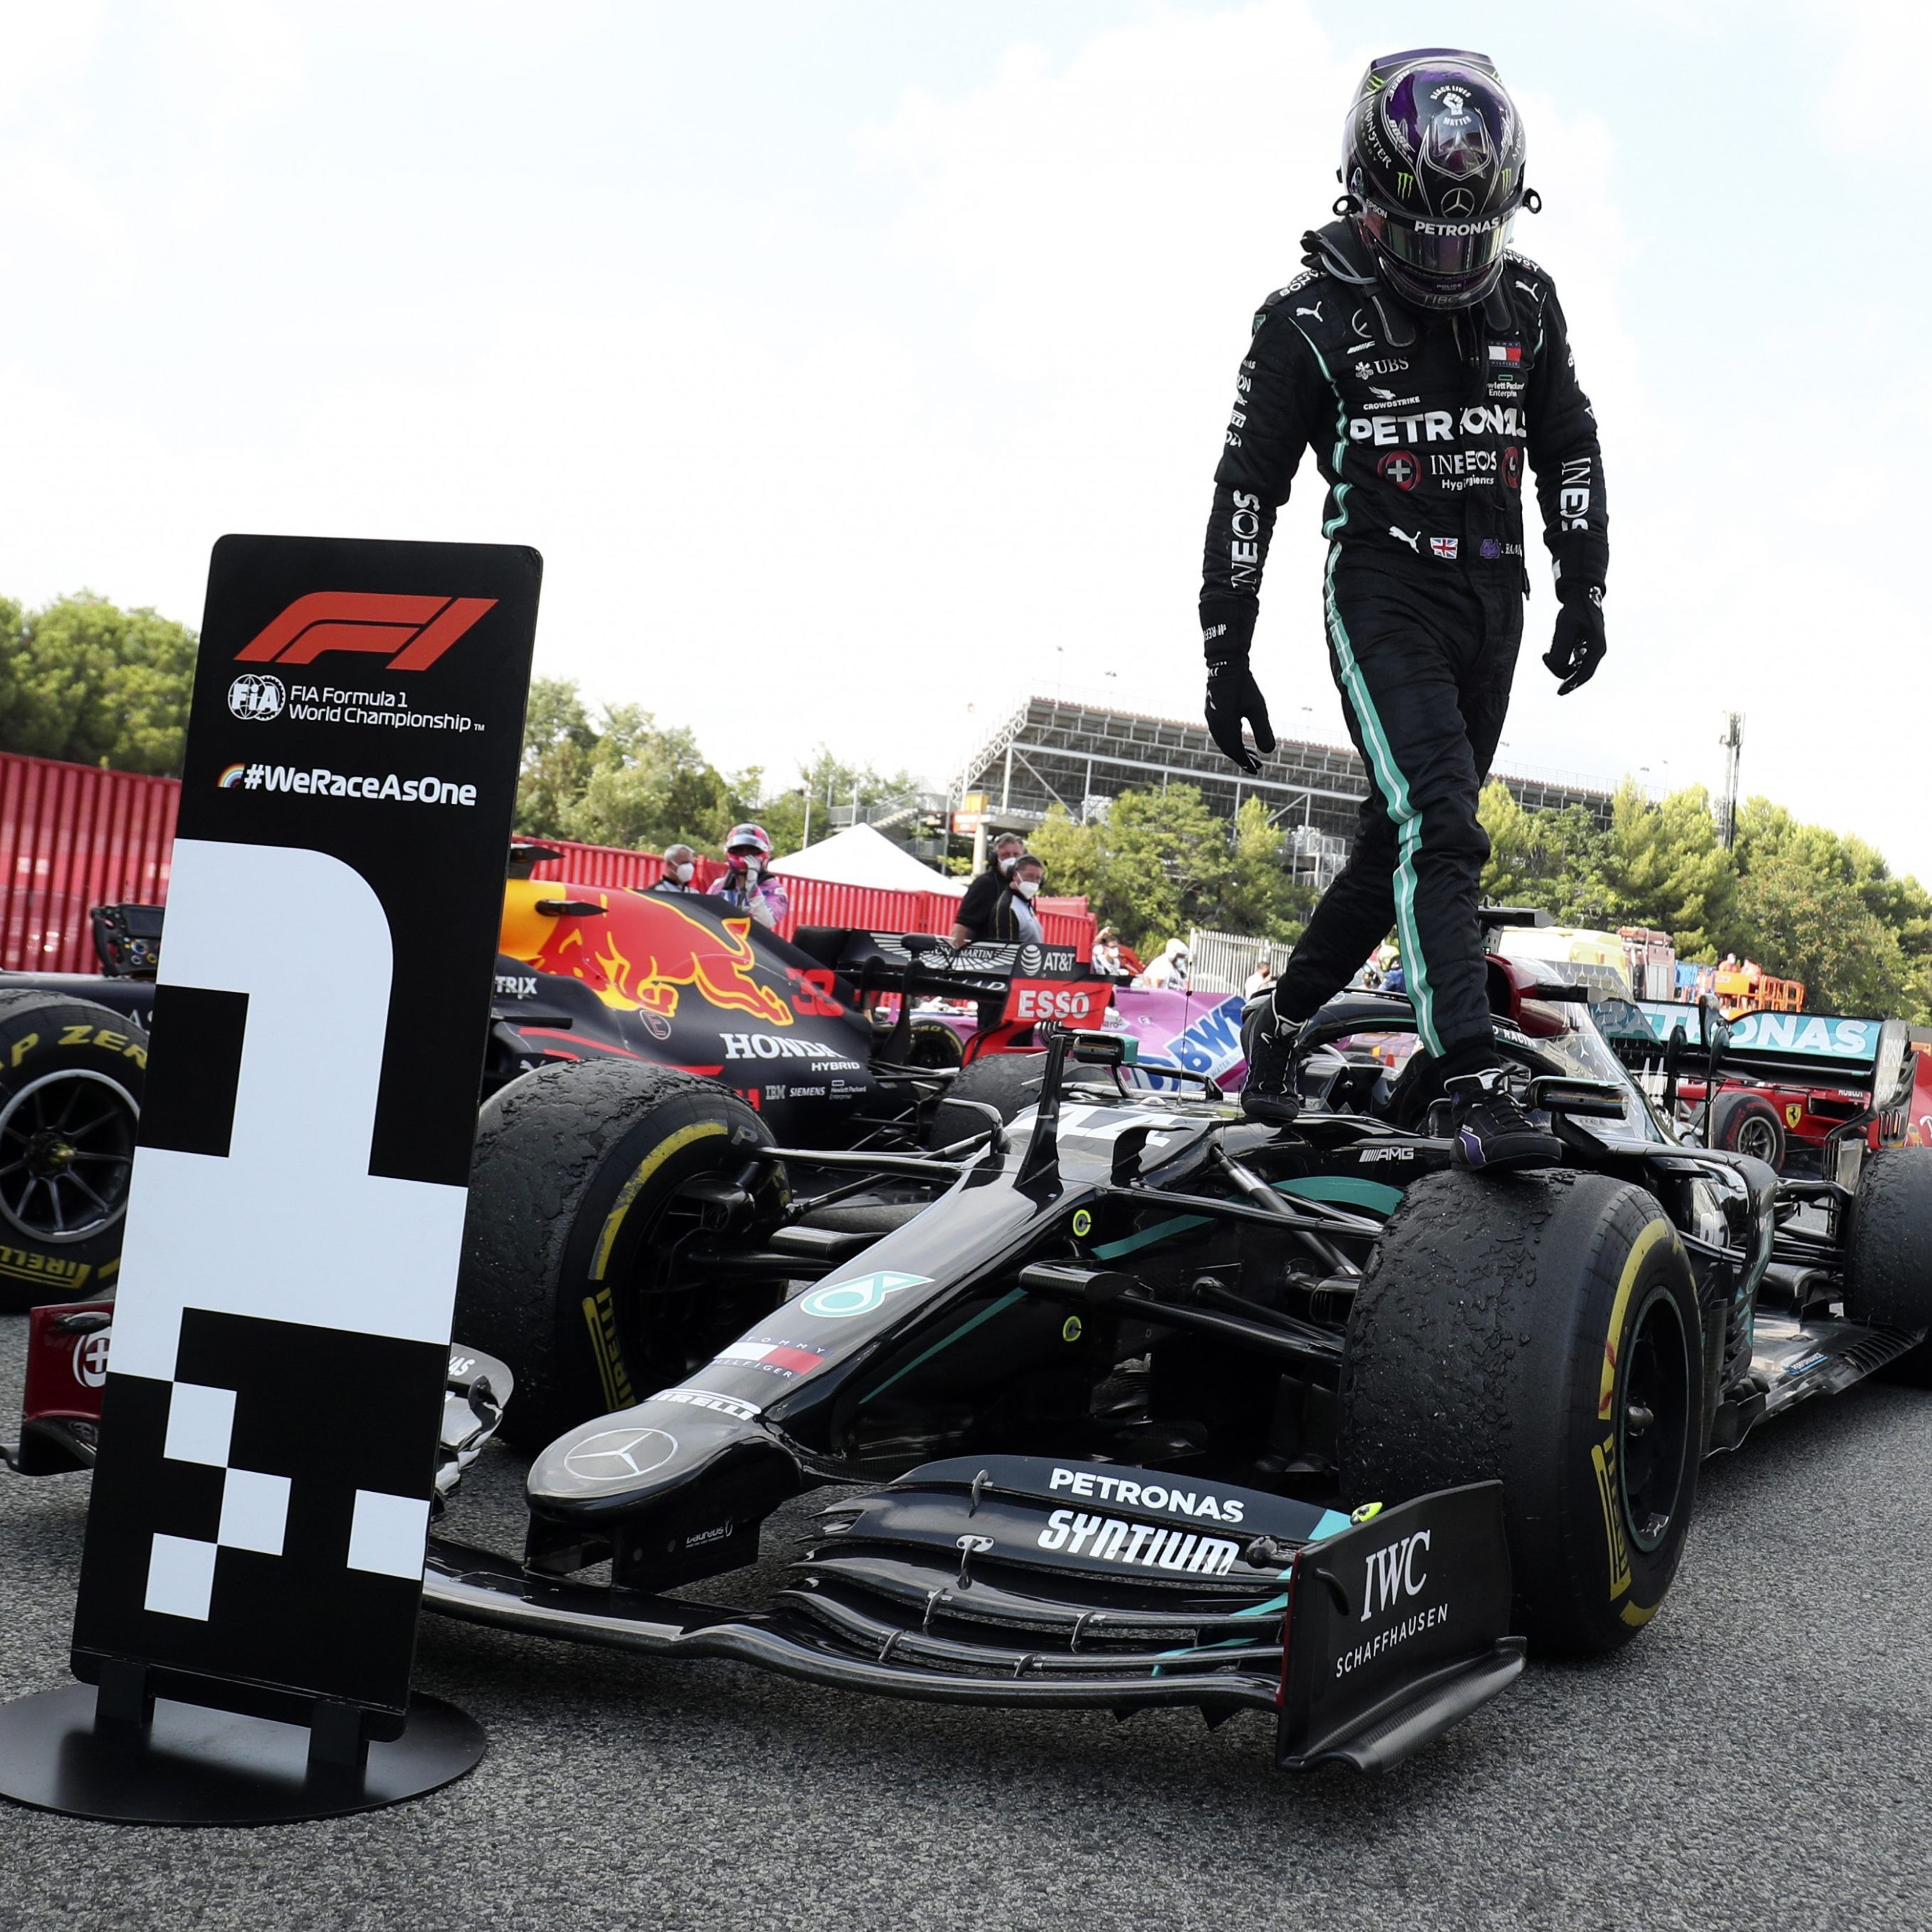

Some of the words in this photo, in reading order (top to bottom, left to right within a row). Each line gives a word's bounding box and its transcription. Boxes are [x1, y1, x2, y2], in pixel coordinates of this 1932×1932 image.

[1430, 85, 1451, 100] BLACK
[1452, 85, 1472, 98] LIVES
[1443, 115, 1473, 127] MATTER
[1366, 198, 1388, 219] EPSON
[1414, 216, 1500, 236] PETRONAS
[1503, 252, 1540, 273] NVOY
[1374, 357, 1409, 375] UBS
[1362, 395, 1421, 411] CROWDSTRIKE
[291, 685, 318, 703] FIA
[323, 687, 396, 707] Formula
[397, 691, 408, 709] 1
[288, 704, 339, 723] World
[344, 707, 471, 732] Championship
[244, 763, 477, 806] #WeRaceAsOne
[1043, 951, 1075, 972] AT&T
[494, 976, 538, 1000] TRIX
[1018, 989, 1090, 1019] ESSO
[11, 1033, 39, 1067] P
[57, 1024, 148, 1070] ZER
[719, 1032, 850, 1059] HONDA
[811, 1062, 861, 1072] HYBRID
[765, 1085, 786, 1100] IBM
[789, 1086, 826, 1097] SIEMENS
[0, 1245, 92, 1290] PIRELL
[746, 1335, 825, 1354] TOMMY
[714, 1358, 793, 1379] HILFIGER
[643, 1388, 762, 1421] PIRELLI
[1048, 1467, 1246, 1523] PETRONAS
[1037, 1509, 1241, 1577] SYNTIUM
[1361, 1529, 1431, 1622] IWC
[1335, 1603, 1449, 1678] SCHAFFHAUSEN
